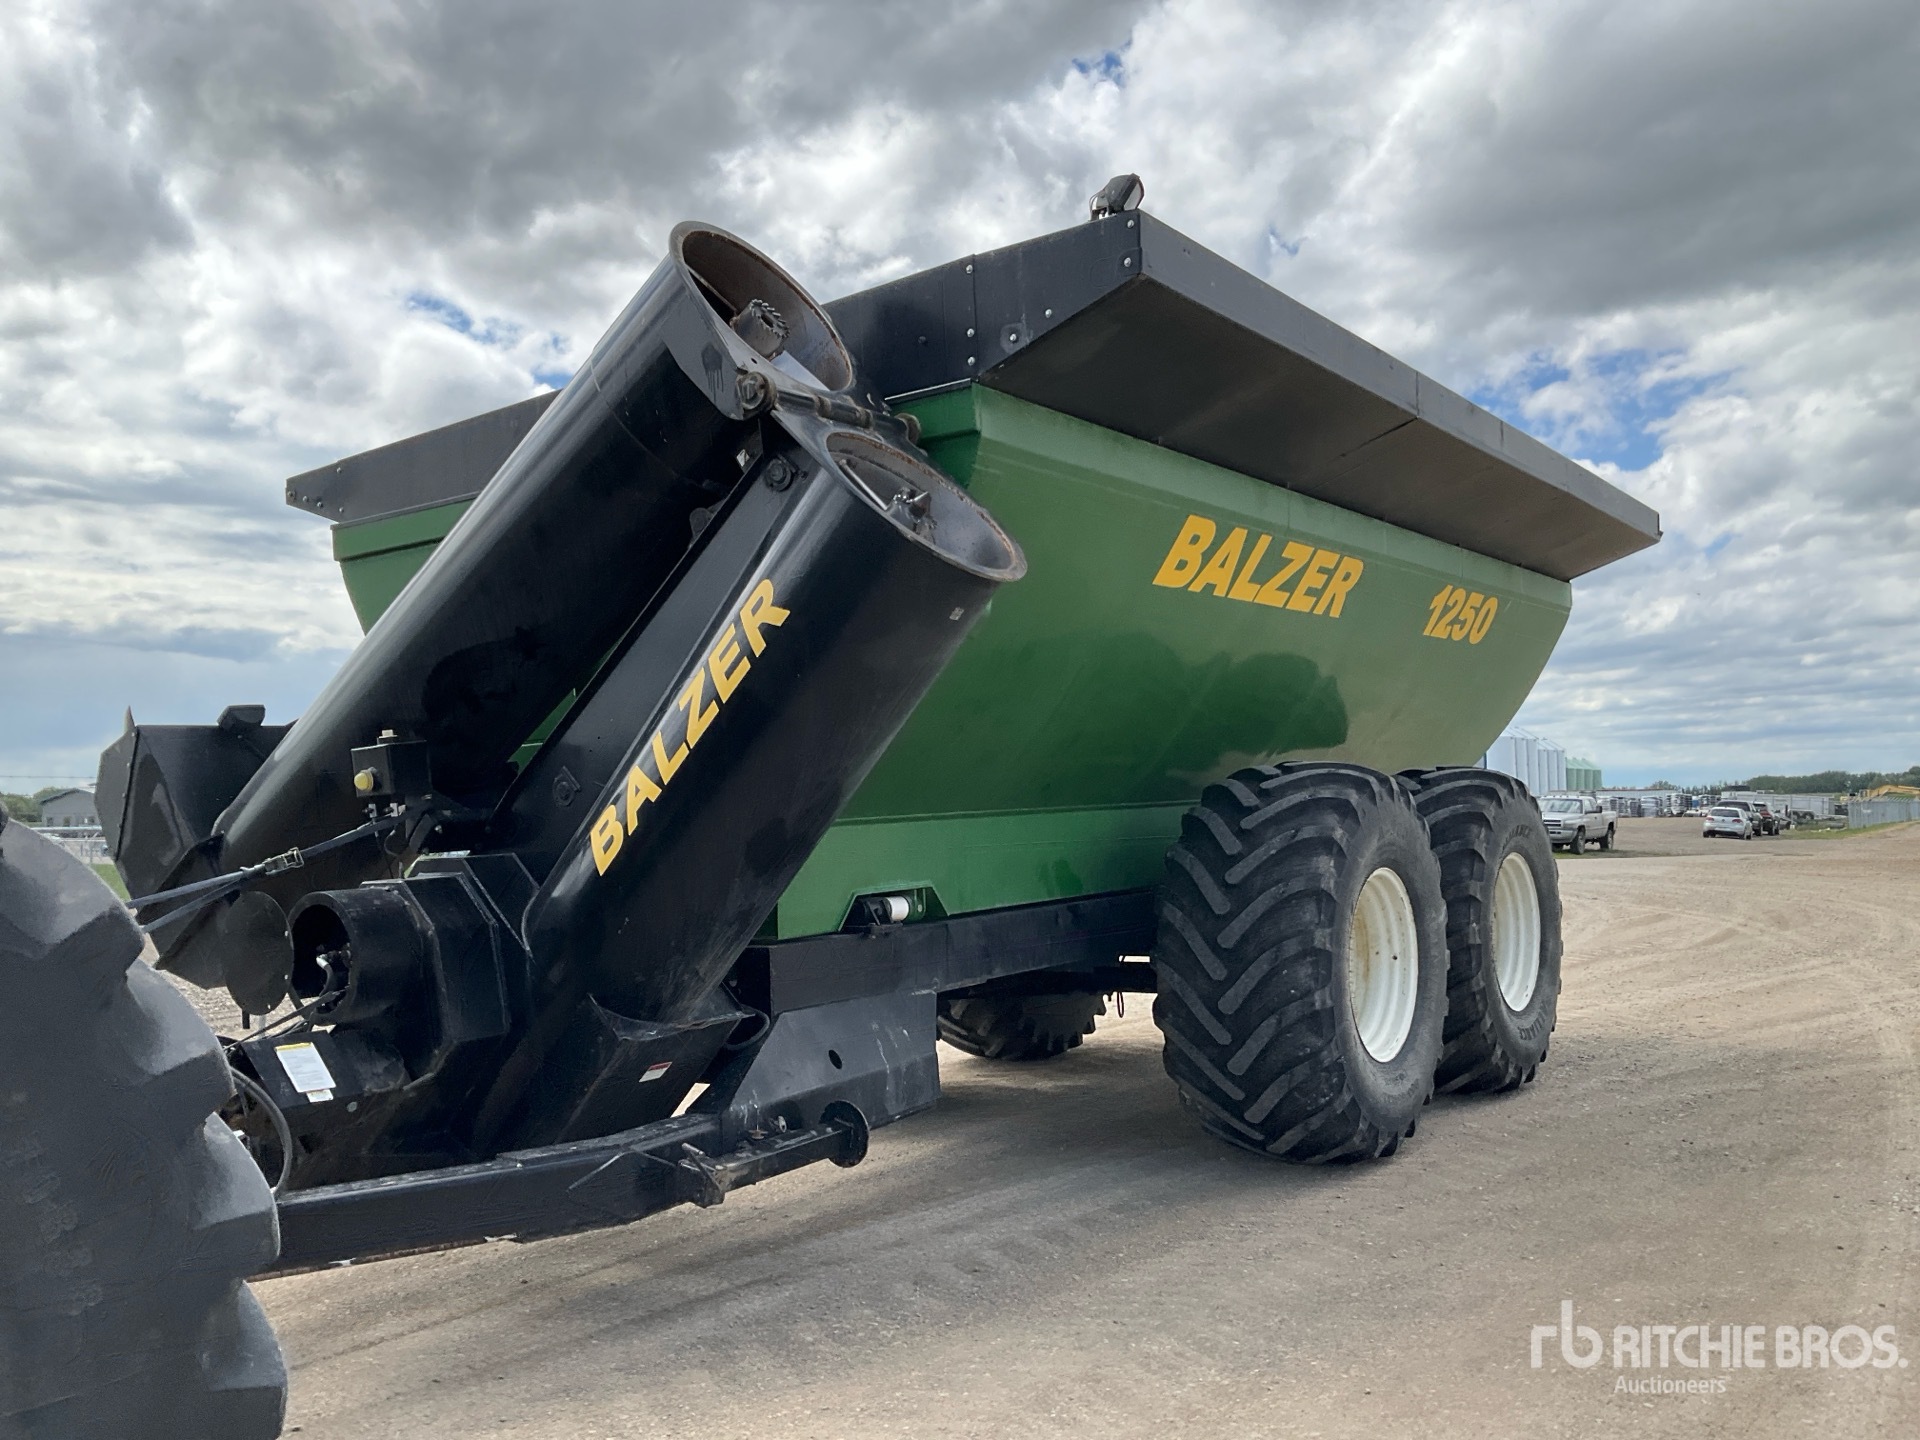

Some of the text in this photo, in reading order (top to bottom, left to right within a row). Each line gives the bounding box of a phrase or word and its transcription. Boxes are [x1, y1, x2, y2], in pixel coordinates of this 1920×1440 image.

[1152, 514, 1364, 618] BALZER
[1423, 585, 1498, 644] 1250
[590, 579, 790, 876] BALZER
